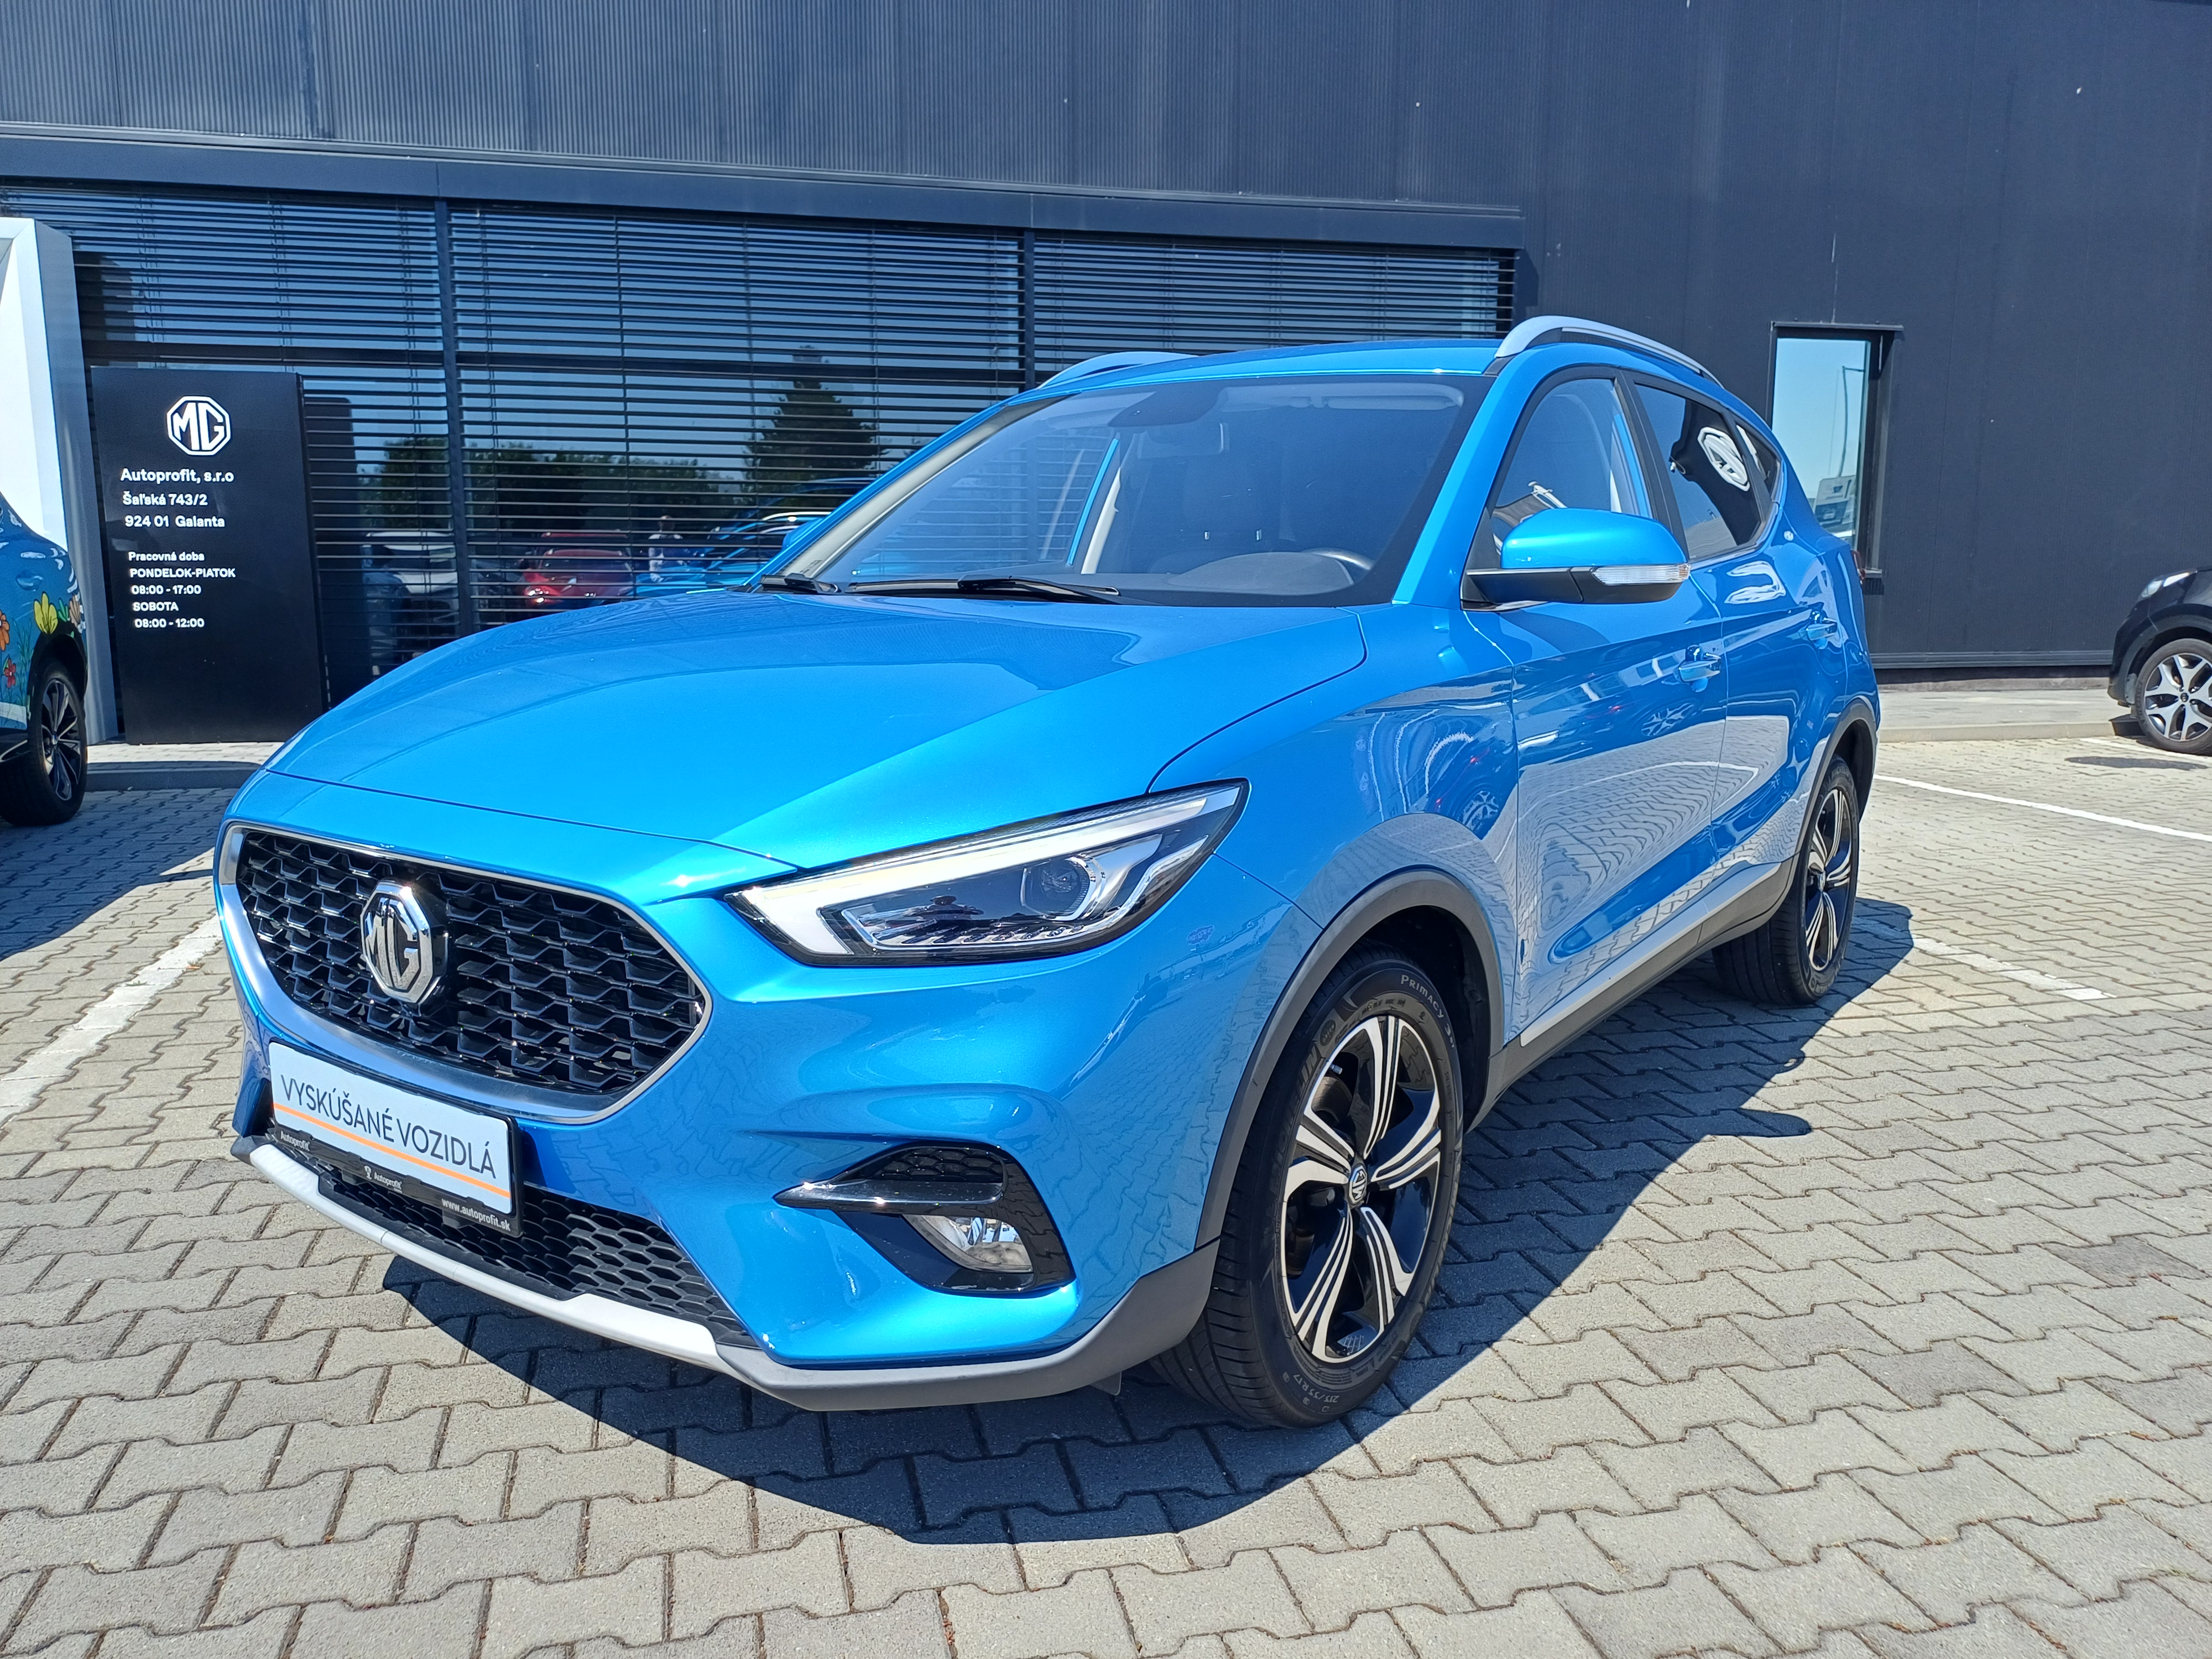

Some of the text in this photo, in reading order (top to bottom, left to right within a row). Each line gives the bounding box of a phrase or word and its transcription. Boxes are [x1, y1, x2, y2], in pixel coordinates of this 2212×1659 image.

[173, 402, 225, 451] MG
[121, 468, 234, 484] Autoprofit, s.r.o
[122, 491, 208, 505] Šaľská 743/2
[124, 515, 225, 528] 924 01 Galanta
[128, 551, 205, 561] Pracovná doba
[129, 568, 236, 578] PONDELOK-PIATOK
[131, 585, 164, 595] 08:00
[172, 585, 202, 594] 17:00
[132, 601, 179, 612] SOBOTA
[134, 618, 167, 628] 08:00
[175, 618, 205, 628] 12:00
[364, 896, 421, 992] MG
[1400, 974, 1444, 1019] PRIMACY
[280, 1074, 497, 1180] VYSKÚŠANÉ VOZIDLÁ
[280, 1130, 310, 1152] Autoprofit
[441, 1198, 511, 1232] www.autoprofit.sk
